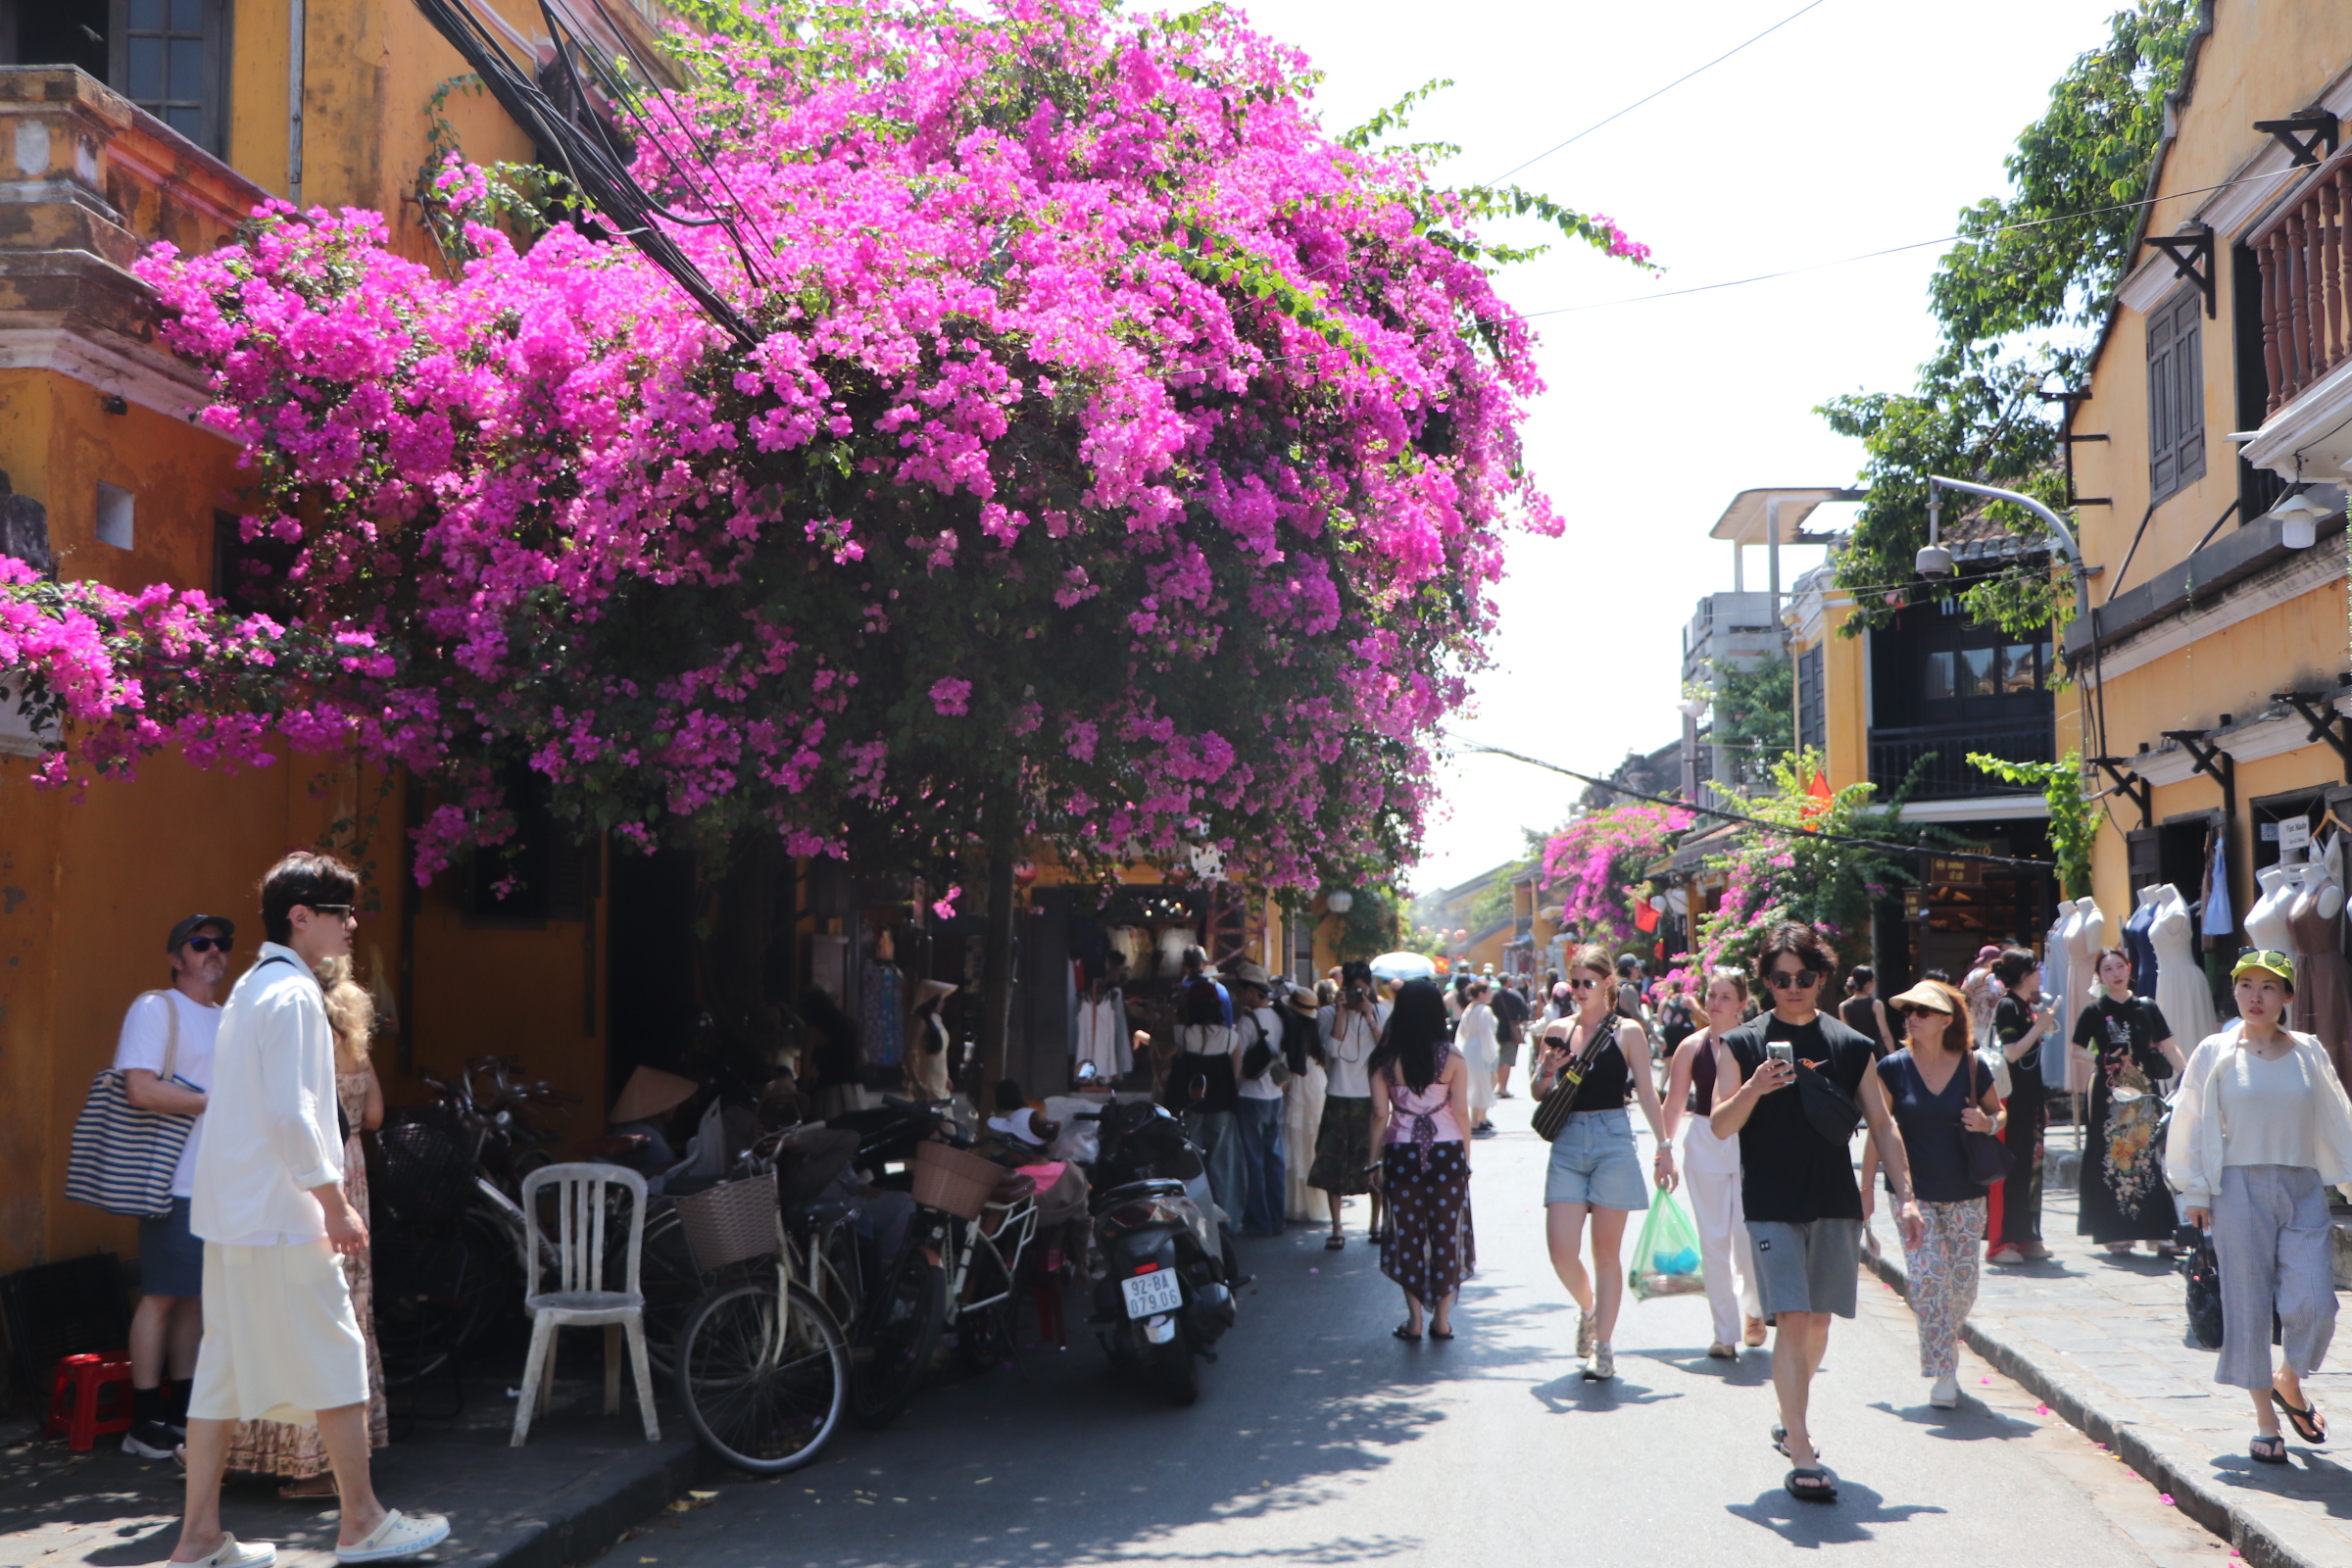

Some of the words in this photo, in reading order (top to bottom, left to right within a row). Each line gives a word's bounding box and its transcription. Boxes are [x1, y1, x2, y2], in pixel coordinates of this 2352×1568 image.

[1131, 1273, 1170, 1297] 92-BA
[1130, 1289, 1178, 1314] 079.06
[395, 1536, 435, 1553] crocs
